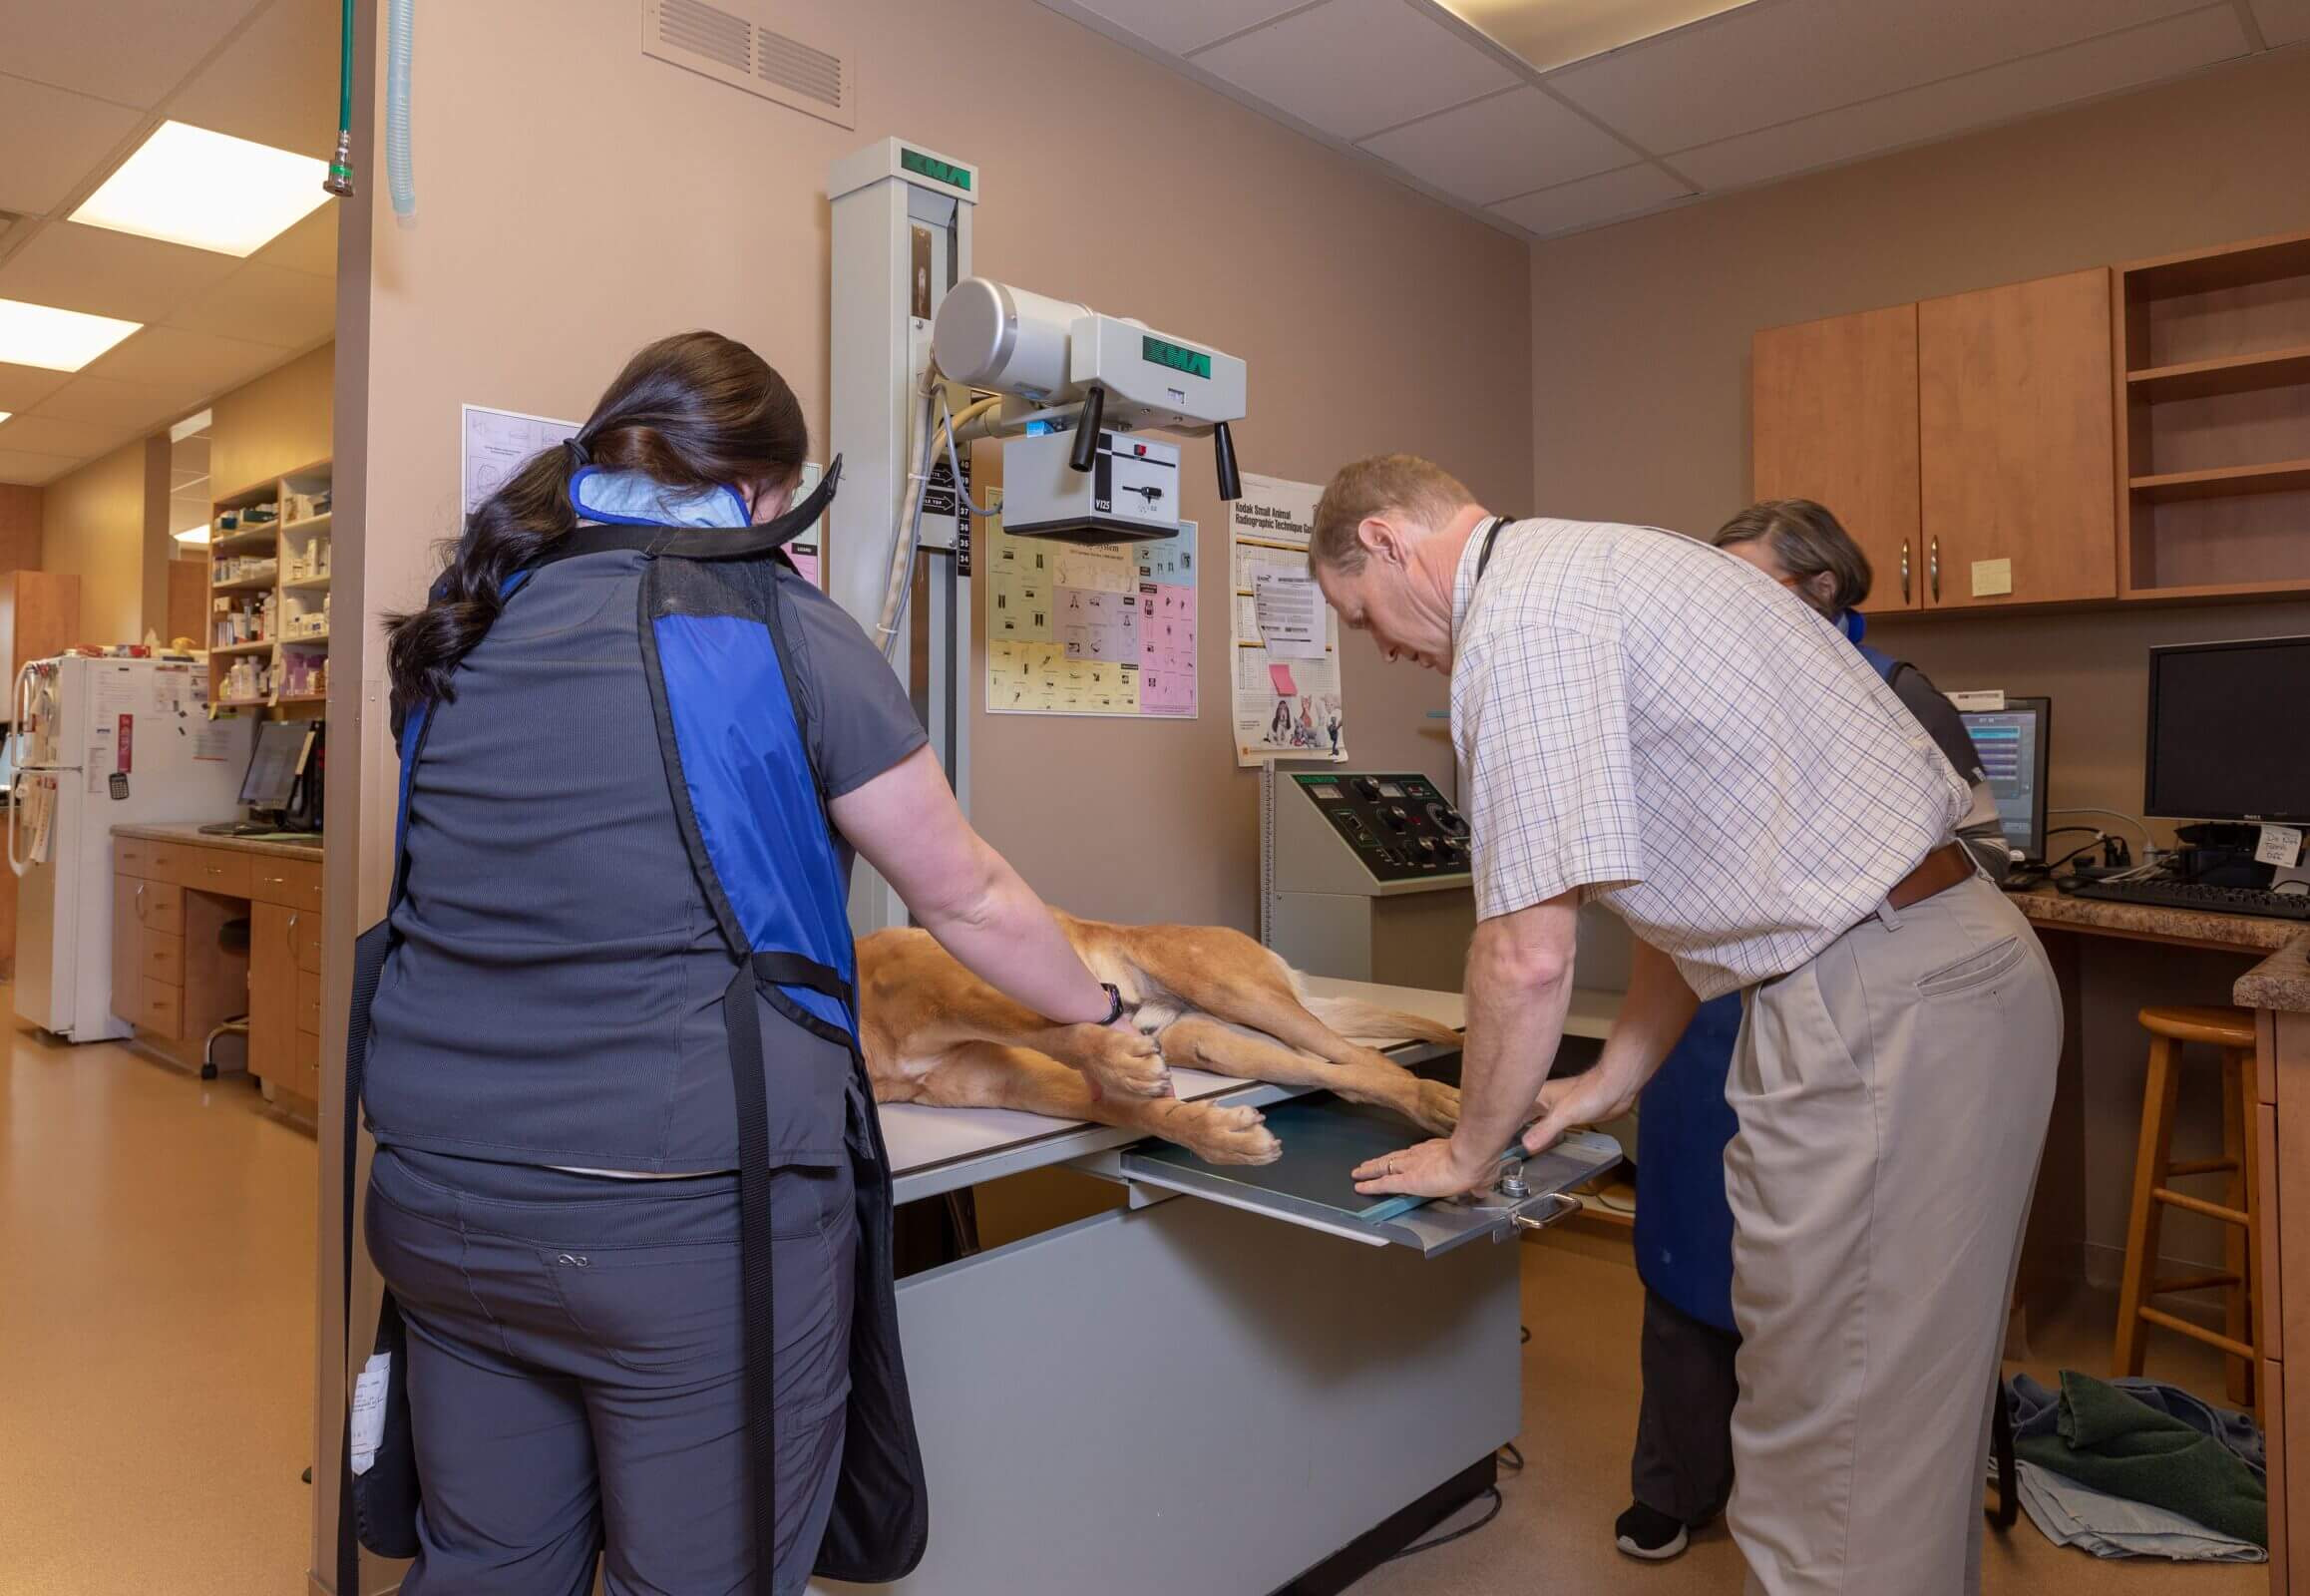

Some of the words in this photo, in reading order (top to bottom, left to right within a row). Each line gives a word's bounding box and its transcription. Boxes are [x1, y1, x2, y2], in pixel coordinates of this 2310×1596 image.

[1236, 502, 1253, 514] Kodak
[1255, 505, 1271, 517] Small
[1272, 508, 1291, 519] Animal
[1236, 514, 1275, 530] Radiographic
[1275, 519, 1303, 535] Technique
